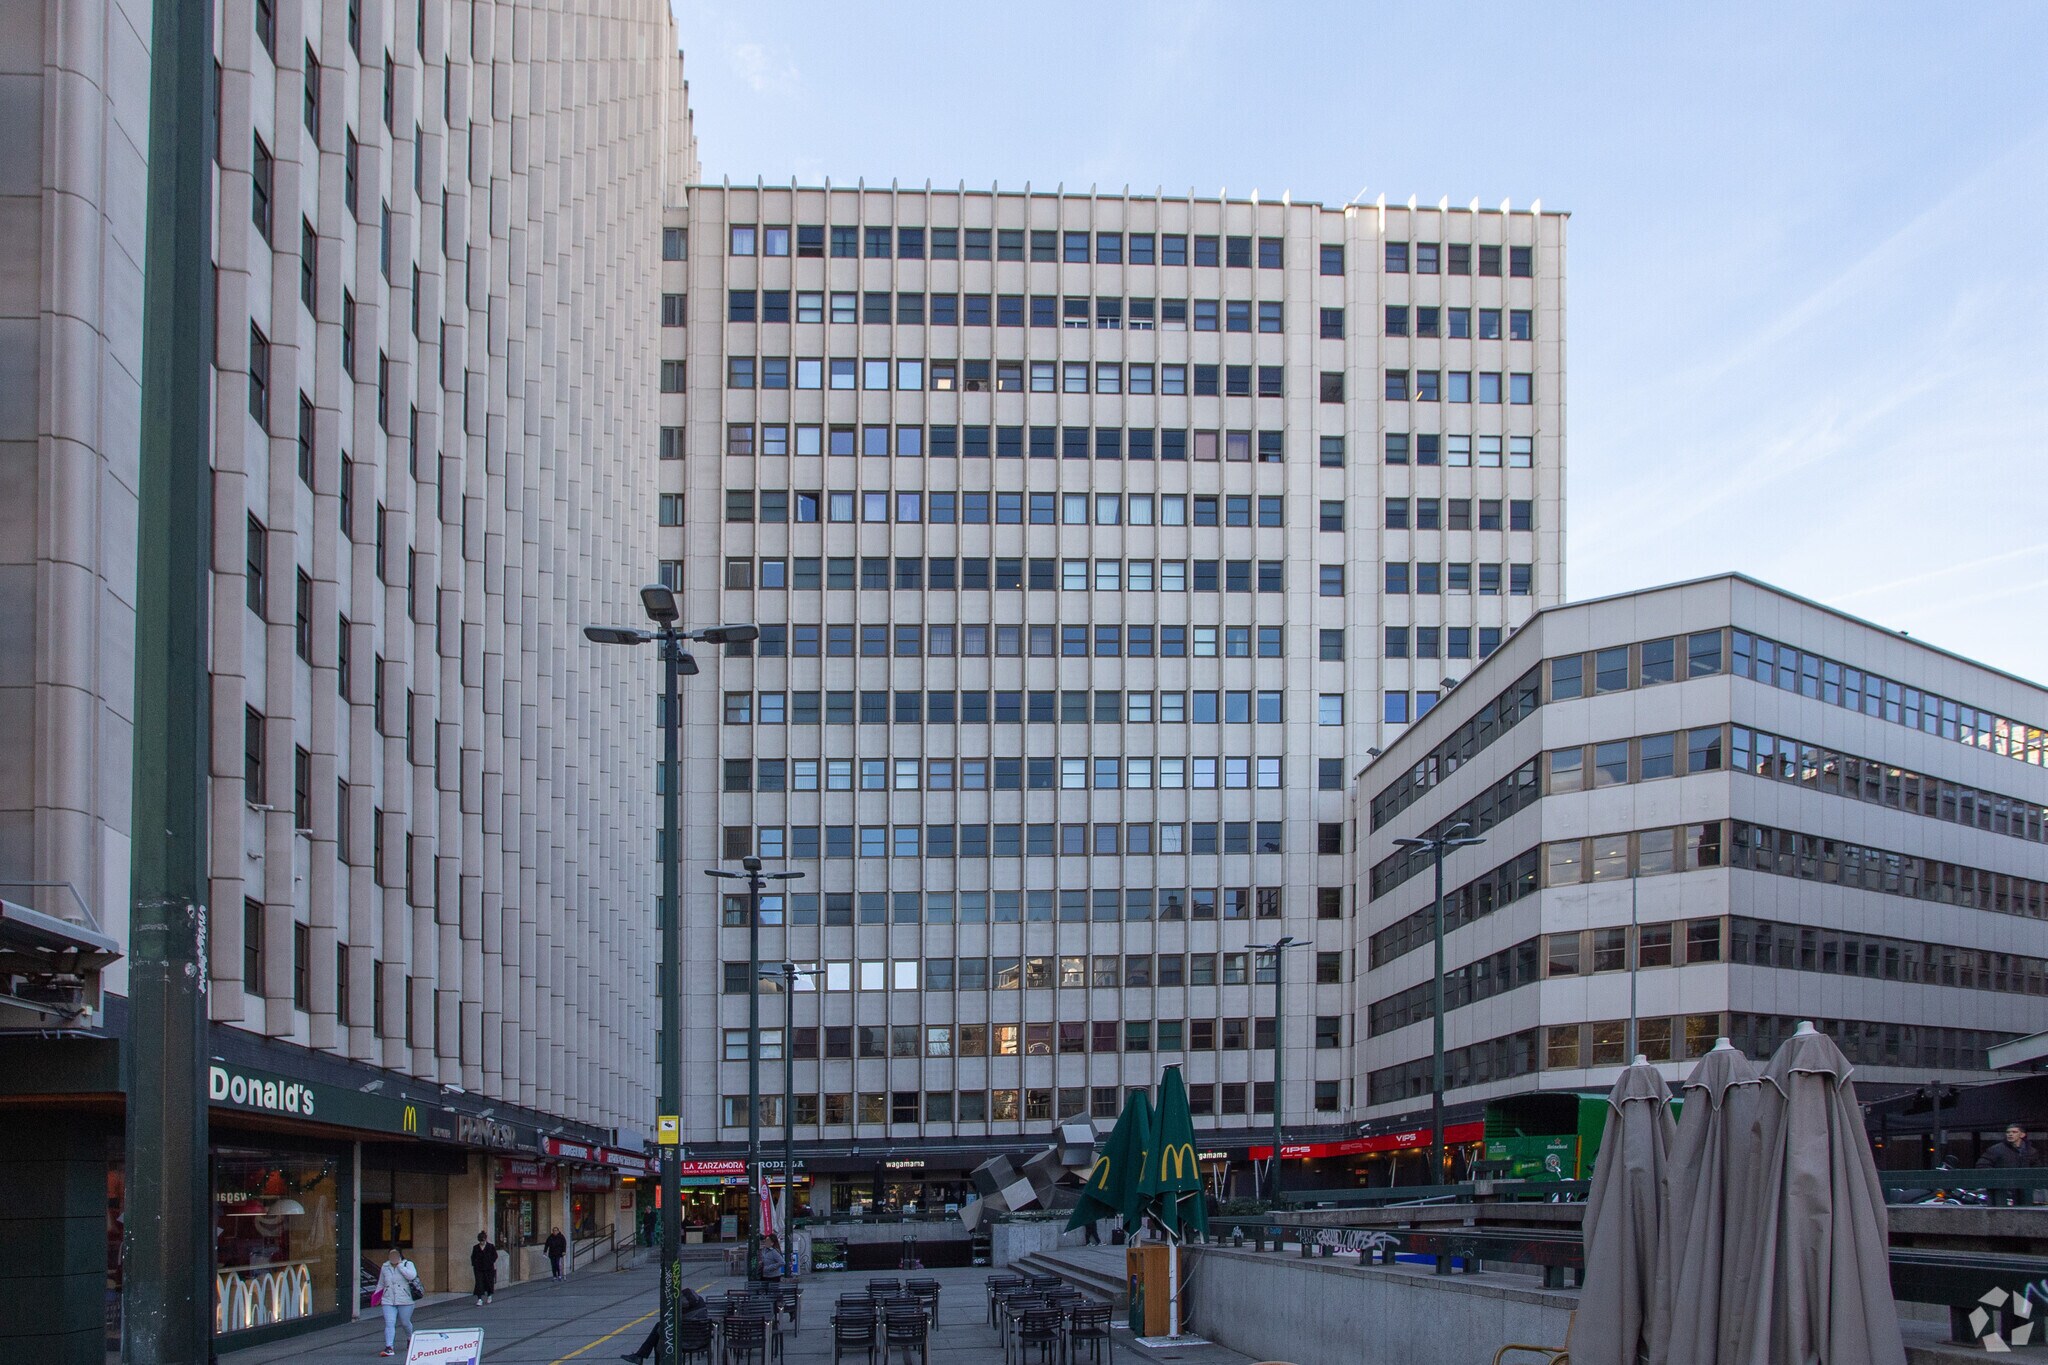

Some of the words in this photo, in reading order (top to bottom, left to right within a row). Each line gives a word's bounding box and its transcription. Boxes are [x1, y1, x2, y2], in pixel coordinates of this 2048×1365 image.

[209, 1066, 314, 1115] Donald's
[1395, 1133, 1416, 1142] VIPS
[1198, 1151, 1228, 1161] gamama
[683, 1162, 694, 1170] LA
[697, 1161, 744, 1169] ZARZAMORA
[760, 1160, 804, 1168] RODILA
[886, 1160, 925, 1169] wagamama
[411, 1347, 453, 1361] ¿Pantalla
[454, 1340, 479, 1351] rota?
